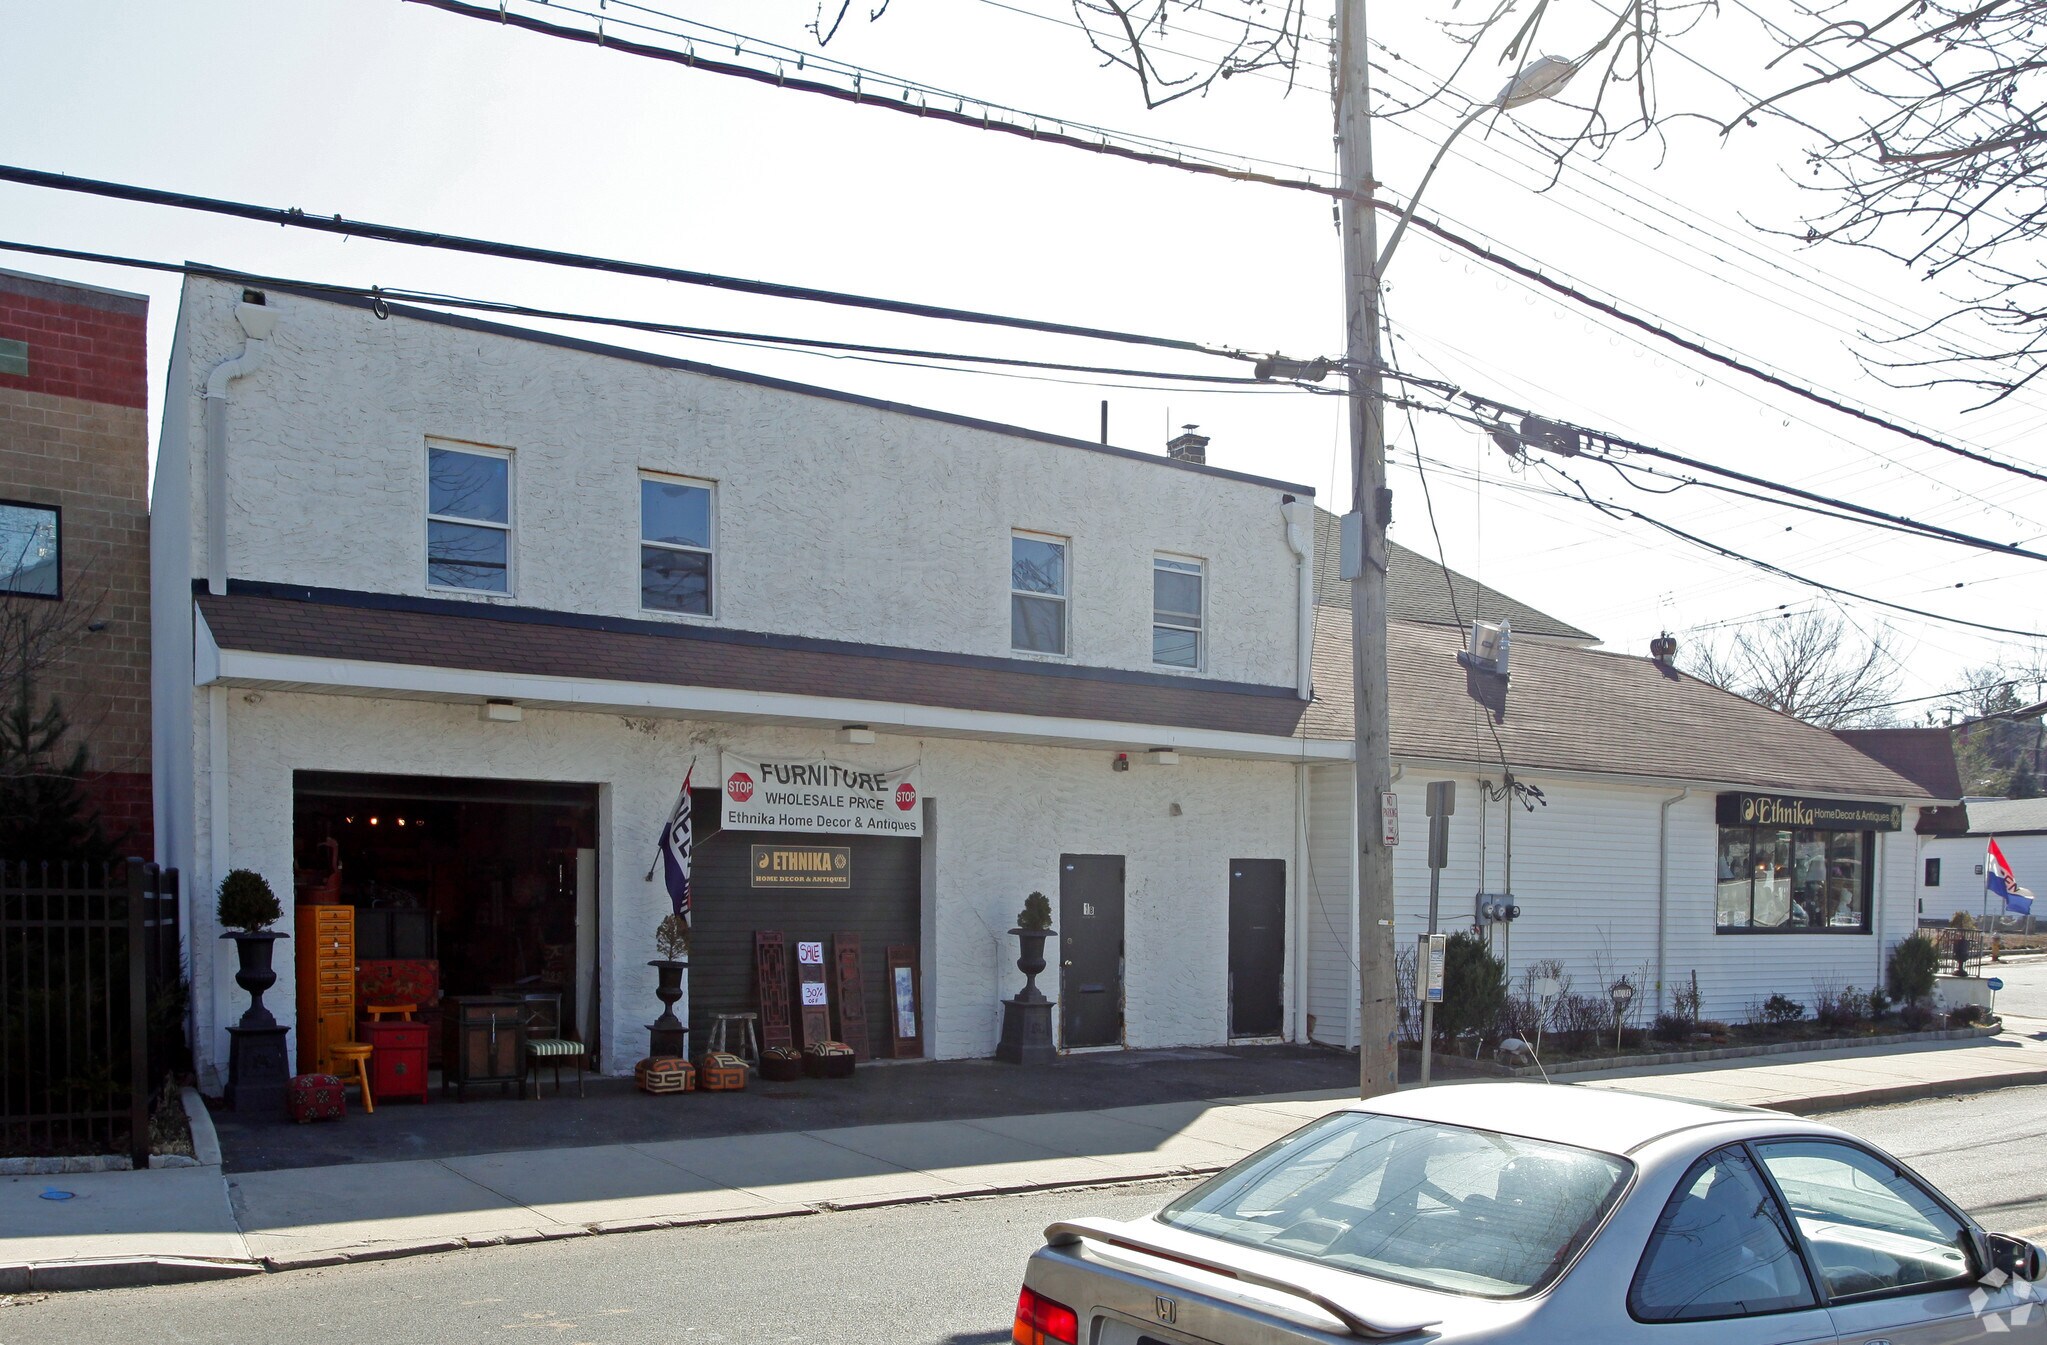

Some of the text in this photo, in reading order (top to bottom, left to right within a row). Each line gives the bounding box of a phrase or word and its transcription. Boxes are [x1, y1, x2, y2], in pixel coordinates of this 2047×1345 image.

[760, 763, 889, 792] FURNITURE
[728, 781, 753, 793] STOP
[765, 792, 885, 810] WHOLESALE PRICE
[896, 791, 916, 803] STOP
[1755, 797, 1814, 825] Ethnika
[1814, 808, 1835, 819] Home
[1835, 809, 1856, 820] Decor
[1862, 811, 1890, 823] Antiques
[728, 811, 917, 832] Ethnika Home Decor & Antiques
[773, 851, 832, 871] ETHNIKA
[812, 876, 847, 884] ANTIQUES
[800, 943, 820, 962] SALE
[805, 987, 823, 998] 30%
